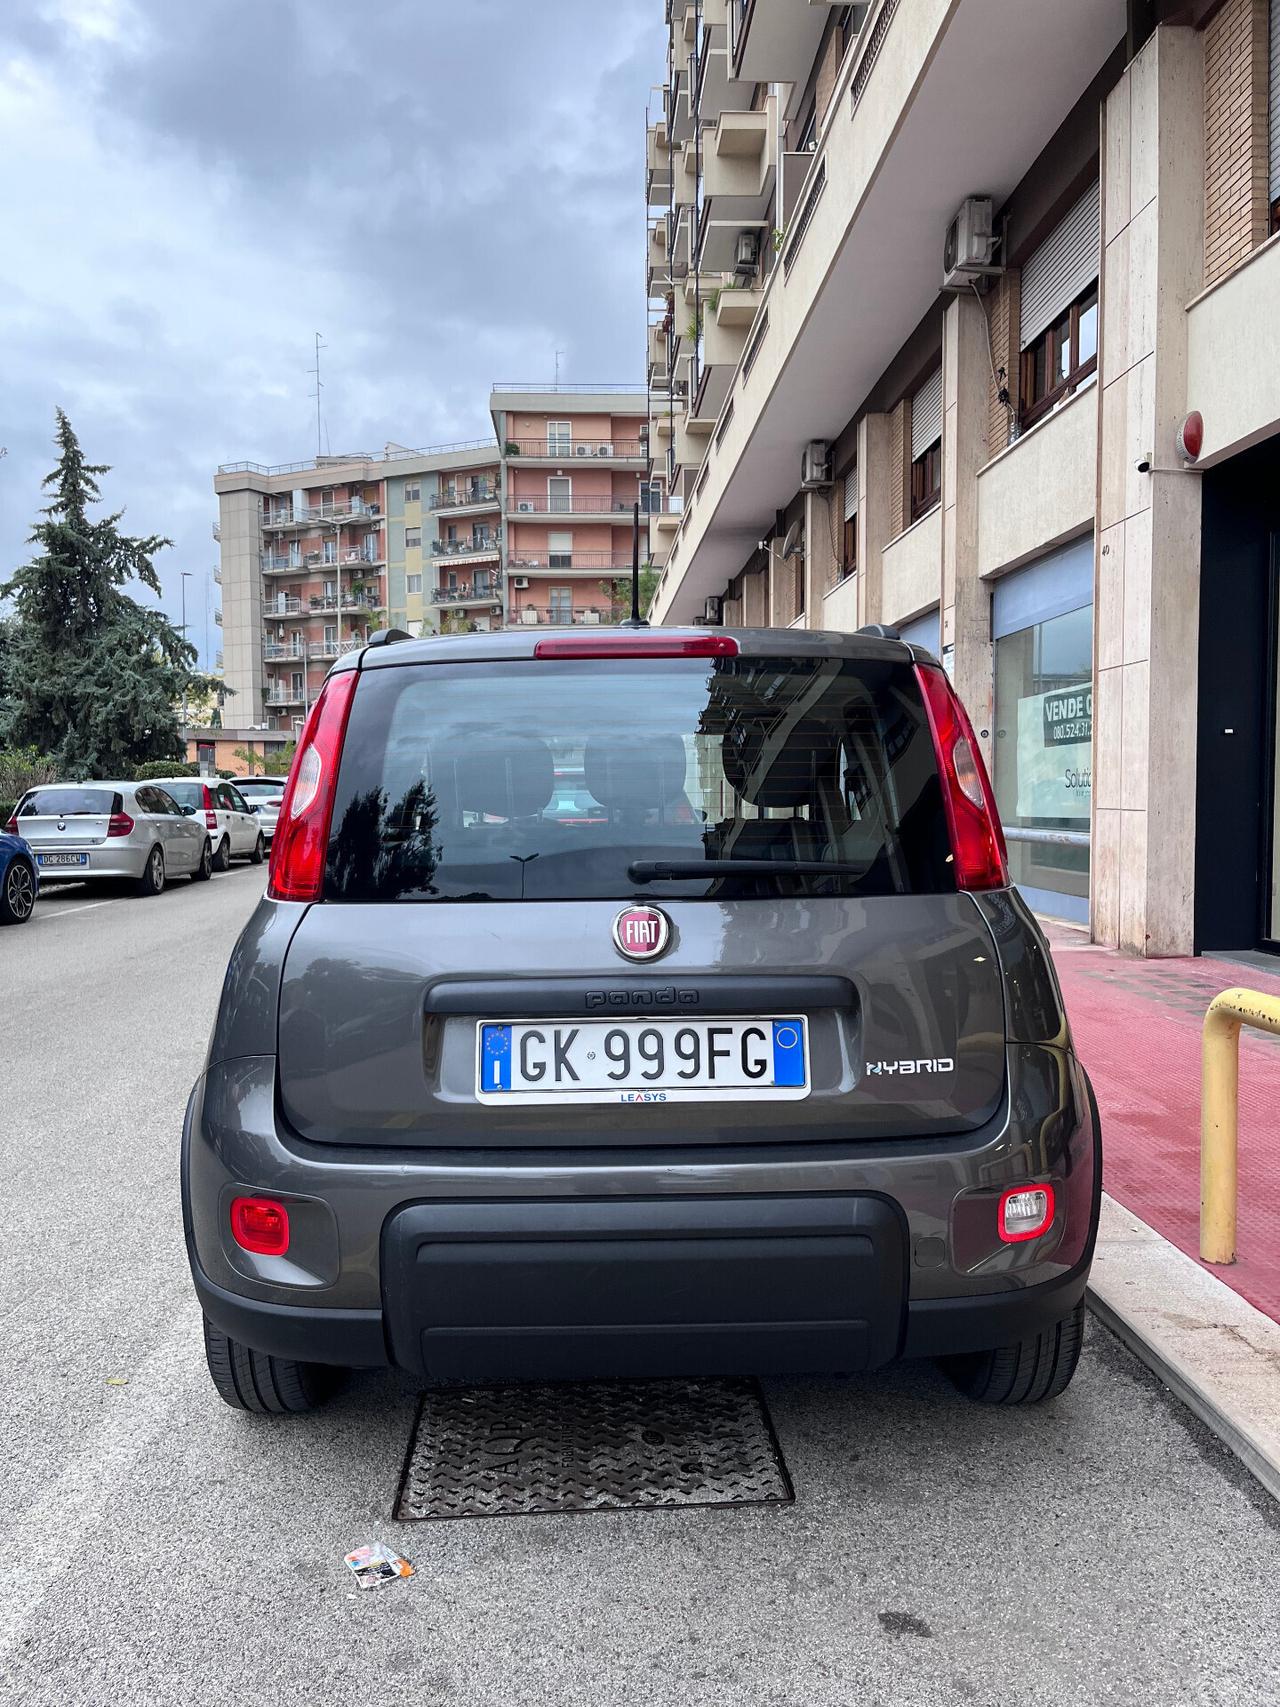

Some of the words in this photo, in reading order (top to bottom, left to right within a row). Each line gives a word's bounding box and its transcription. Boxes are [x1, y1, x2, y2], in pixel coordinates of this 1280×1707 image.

[1045, 696, 1084, 722] VENDE
[1053, 722, 1092, 740] 080.524.31.
[626, 920, 658, 944] FIAT
[585, 986, 700, 1009] panda
[520, 1028, 580, 1082] GK
[604, 1027, 767, 1080] 999FG
[866, 1058, 954, 1075] HYBRID
[621, 1092, 667, 1102] LEASYS
[484, 1421, 537, 1476] AQP
